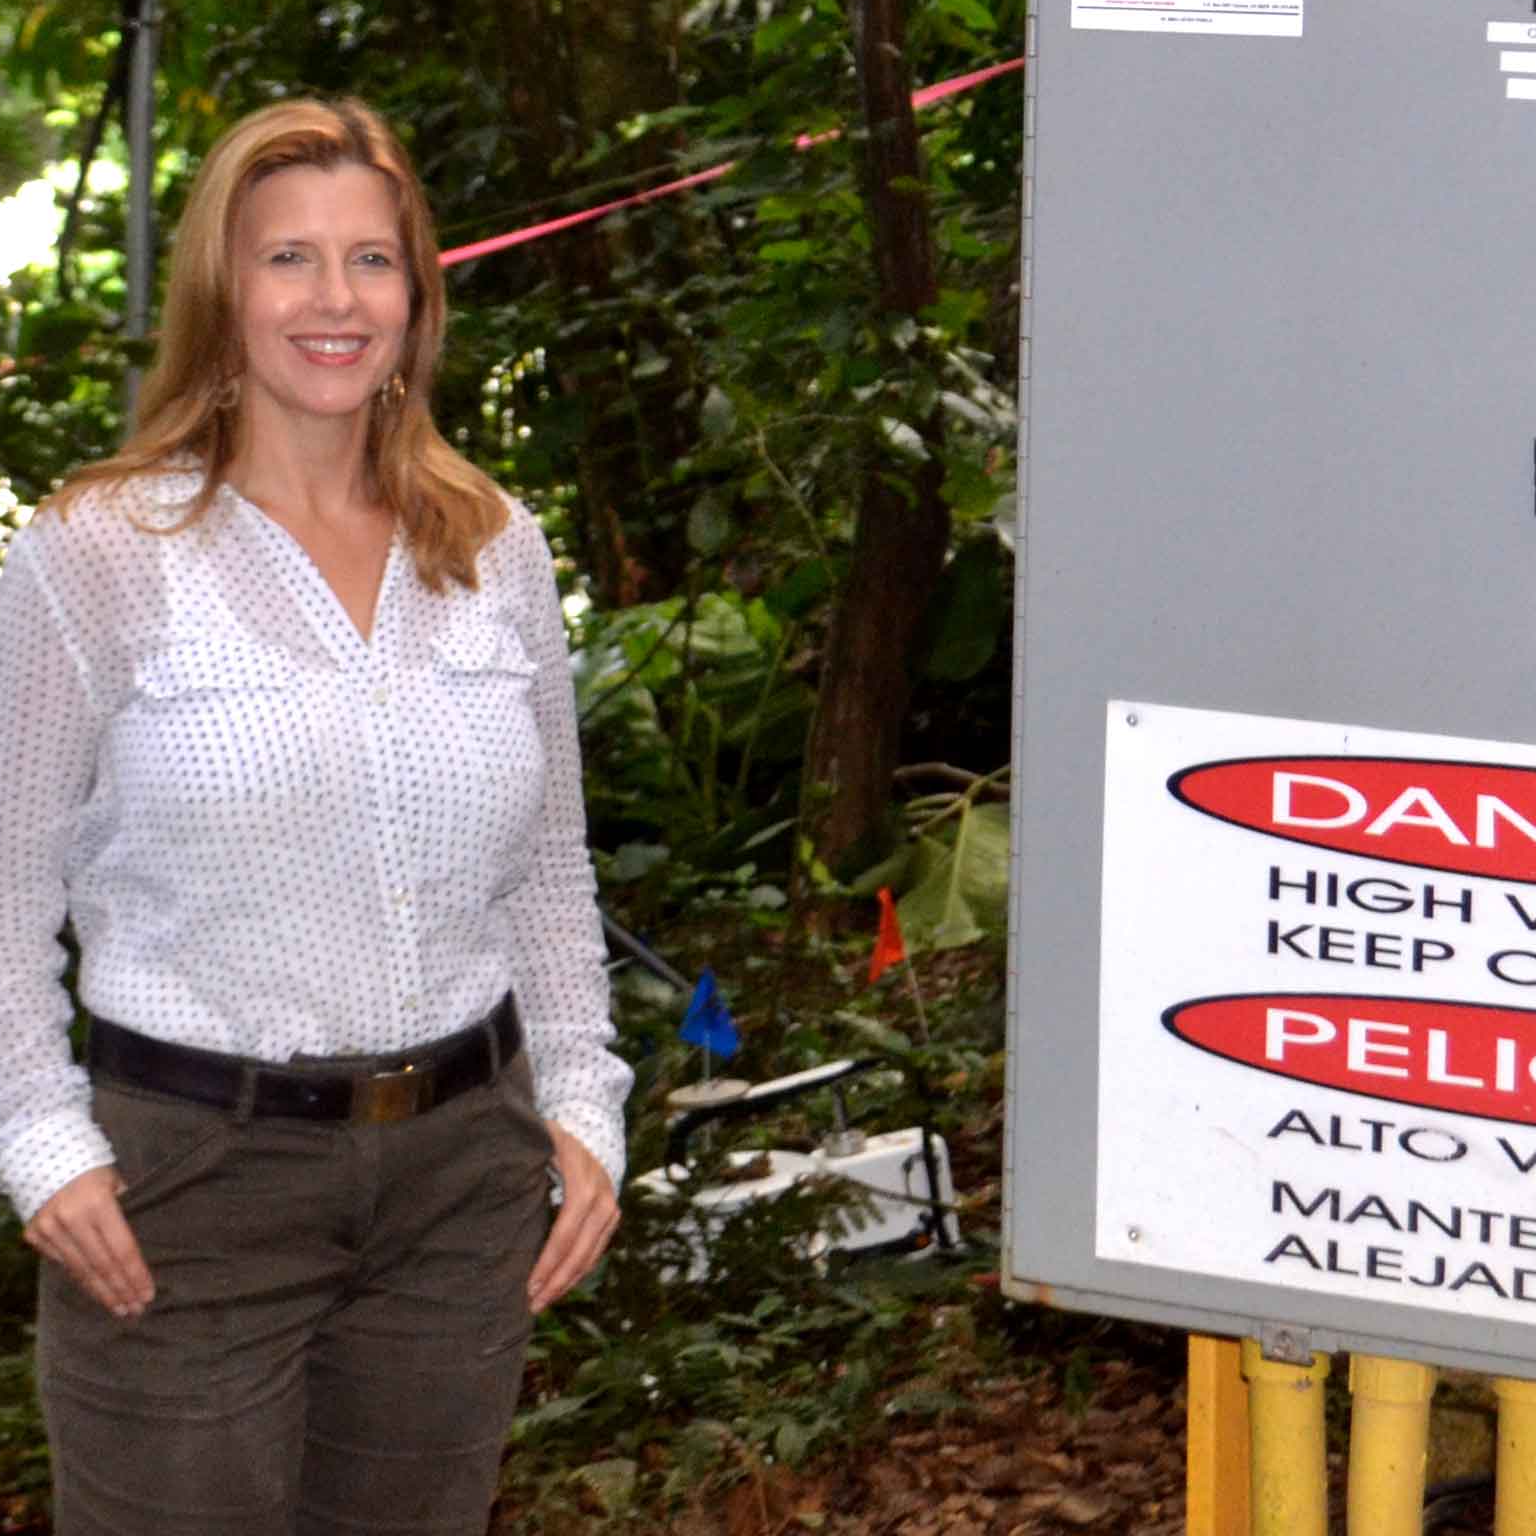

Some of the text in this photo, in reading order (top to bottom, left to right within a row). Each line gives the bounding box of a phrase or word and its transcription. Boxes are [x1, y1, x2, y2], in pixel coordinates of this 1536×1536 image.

[1267, 866, 1473, 924] HIGH
[1267, 920, 1457, 974] KEEP
[1266, 1109, 1469, 1163] ALTO
